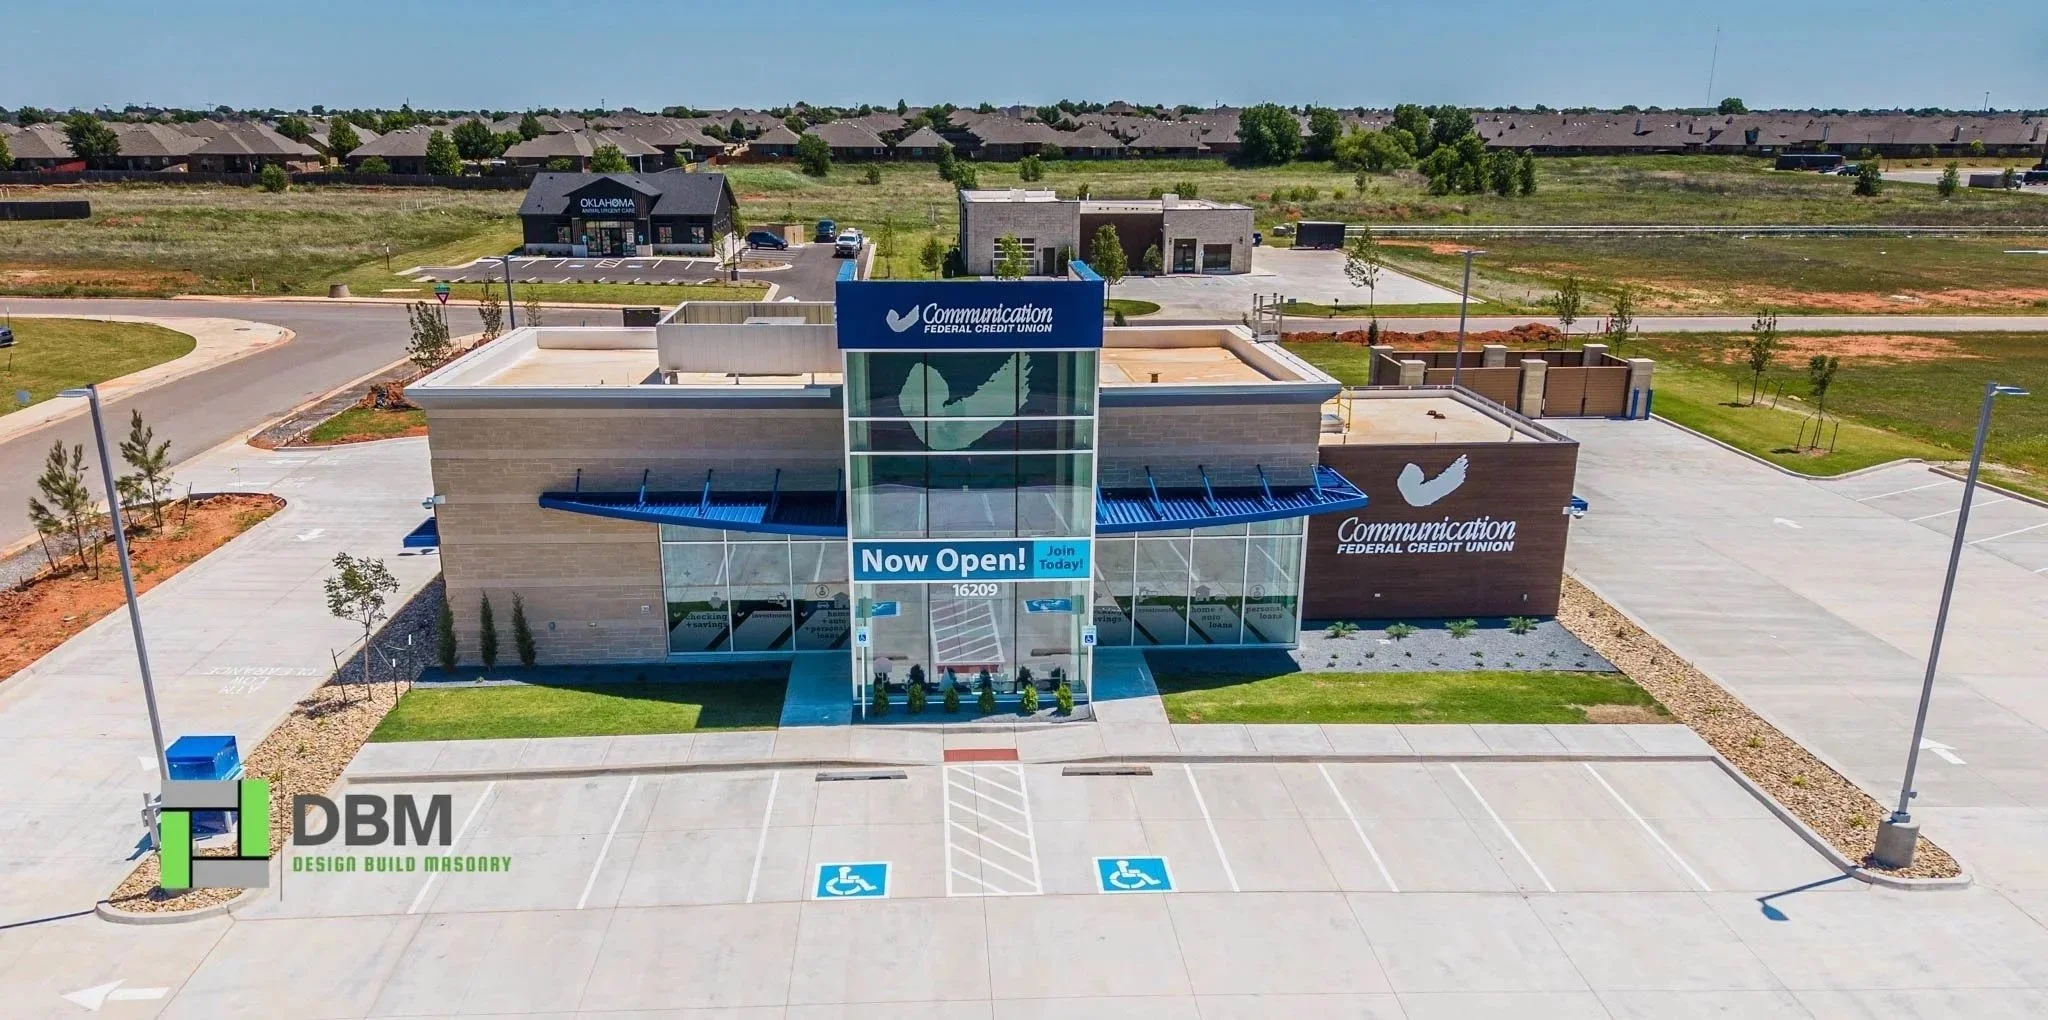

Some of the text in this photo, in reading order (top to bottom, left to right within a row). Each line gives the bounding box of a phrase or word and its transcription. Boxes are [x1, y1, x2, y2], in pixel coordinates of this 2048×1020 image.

[580, 198, 635, 208] OKLAHOMA
[923, 303, 1053, 324] Communication
[924, 324, 1053, 333] FEDERAL CREDIT UNION
[1337, 515, 1516, 543] Communication
[1047, 545, 1075, 557] Join
[1337, 541, 1515, 554] FEDERAL CREDIT UNION
[861, 547, 1026, 578] Now Open!
[1039, 558, 1084, 573] Today!
[952, 583, 998, 597] 16209
[1246, 605, 1283, 614] personal
[1209, 621, 1233, 629] loans
